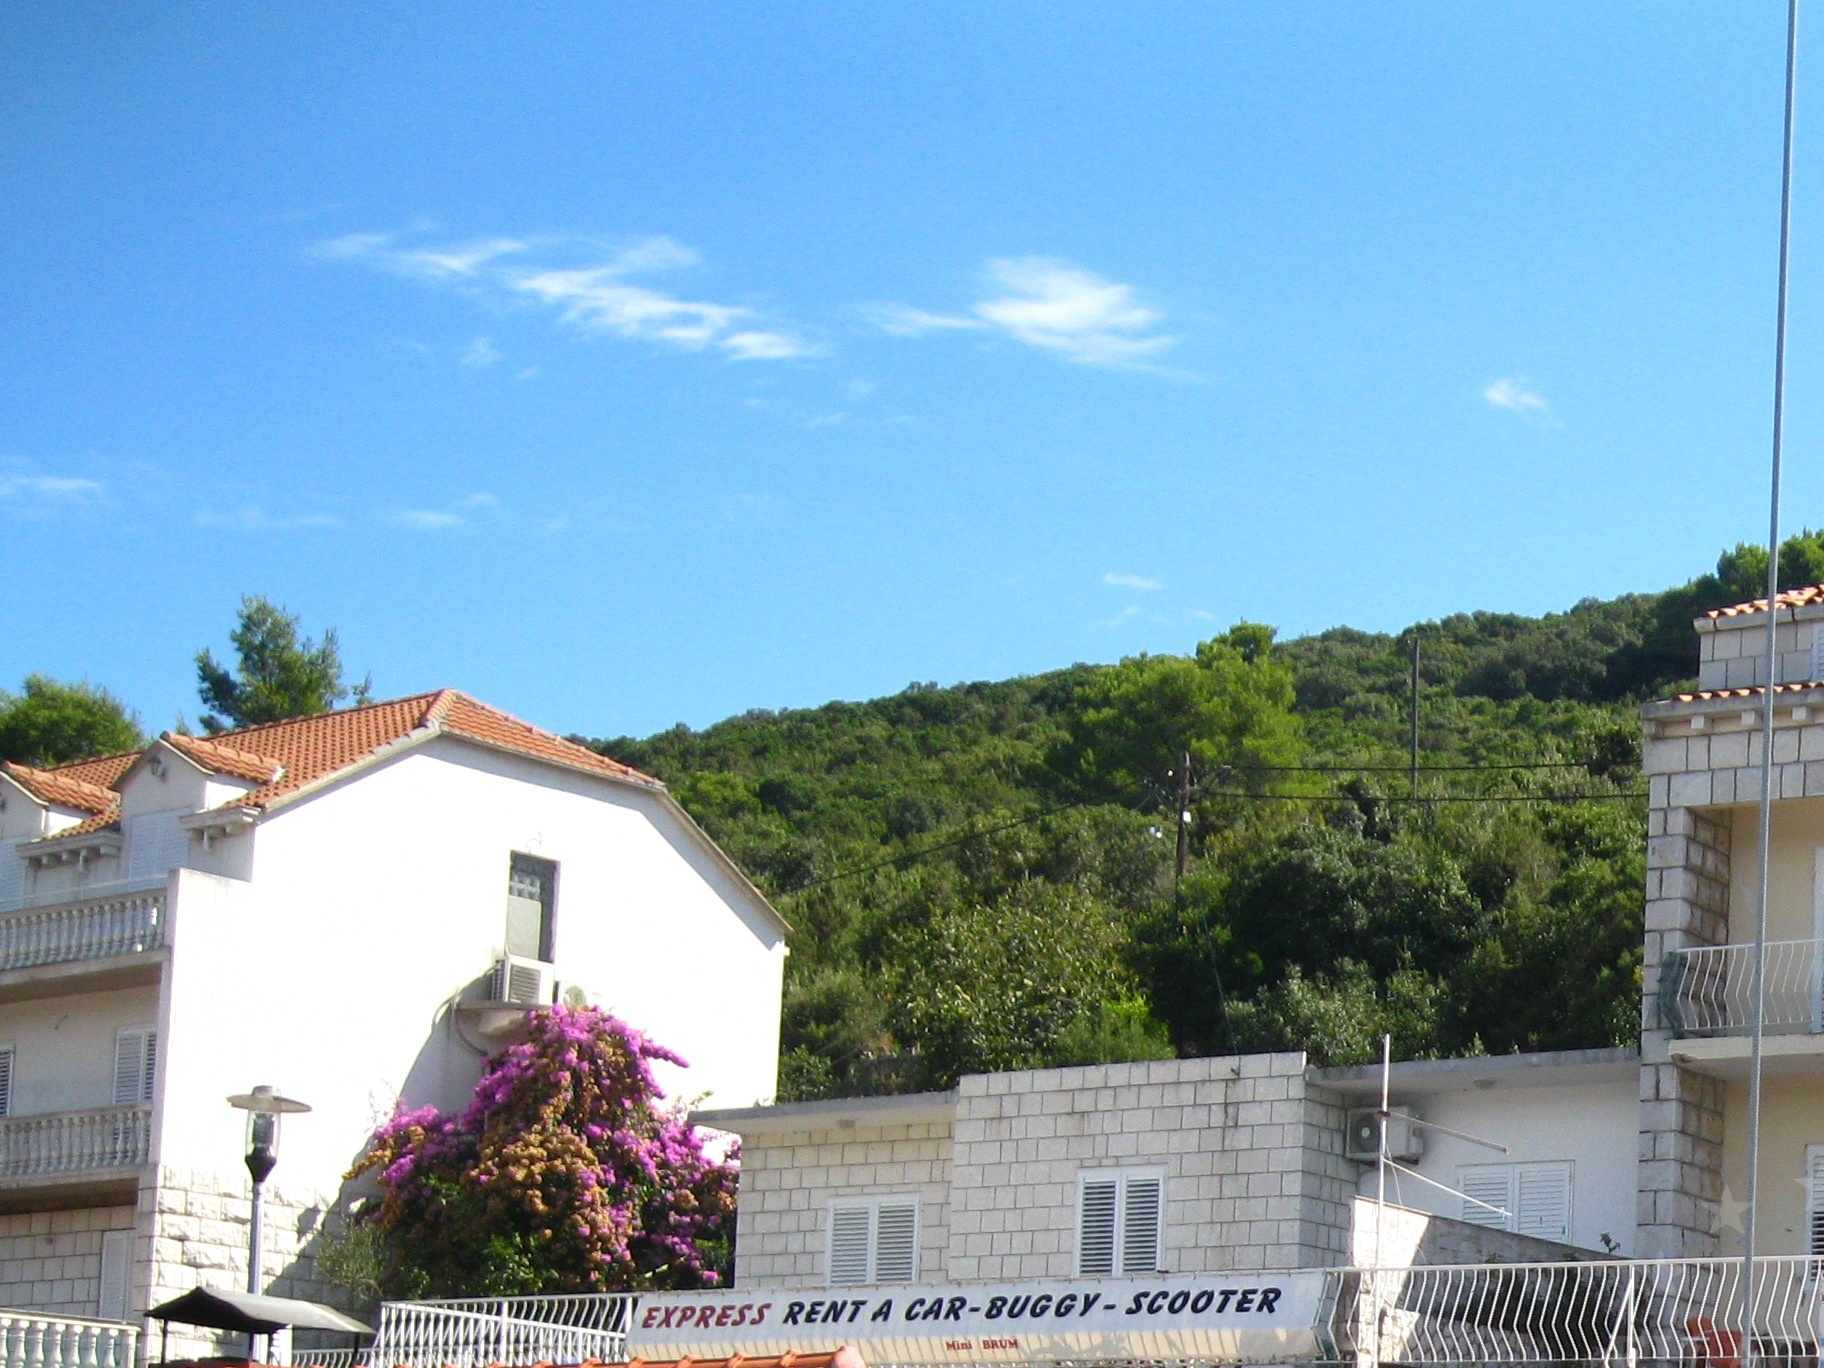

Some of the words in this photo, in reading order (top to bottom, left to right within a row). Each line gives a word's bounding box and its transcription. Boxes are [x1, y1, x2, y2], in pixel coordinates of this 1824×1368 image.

[641, 1302, 772, 1329] EXPRESS
[782, 1299, 868, 1326] RENT
[869, 1298, 893, 1323] A
[945, 1340, 973, 1351] Mini
[982, 1338, 1019, 1350] BRUM
